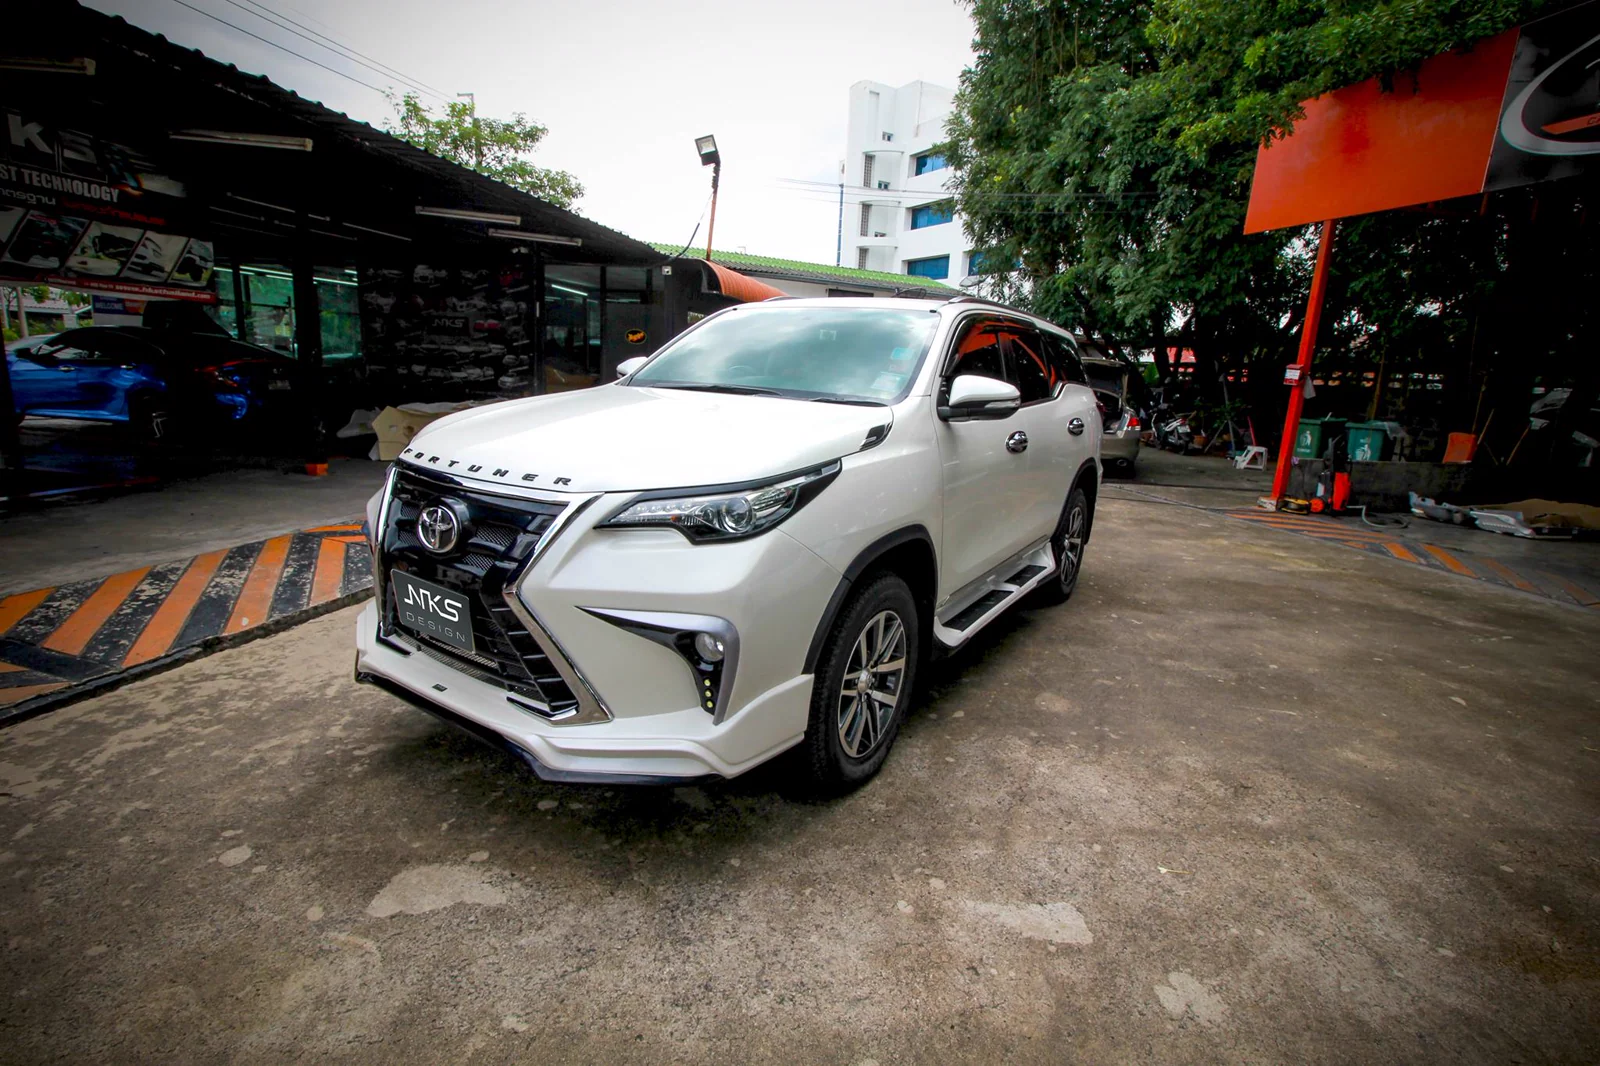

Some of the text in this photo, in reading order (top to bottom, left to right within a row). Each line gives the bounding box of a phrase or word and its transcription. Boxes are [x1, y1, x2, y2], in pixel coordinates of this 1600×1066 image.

[20, 167, 120, 204] TECHNOLOGY
[403, 447, 572, 486] FORTUNER
[406, 611, 467, 643] DESIGN
